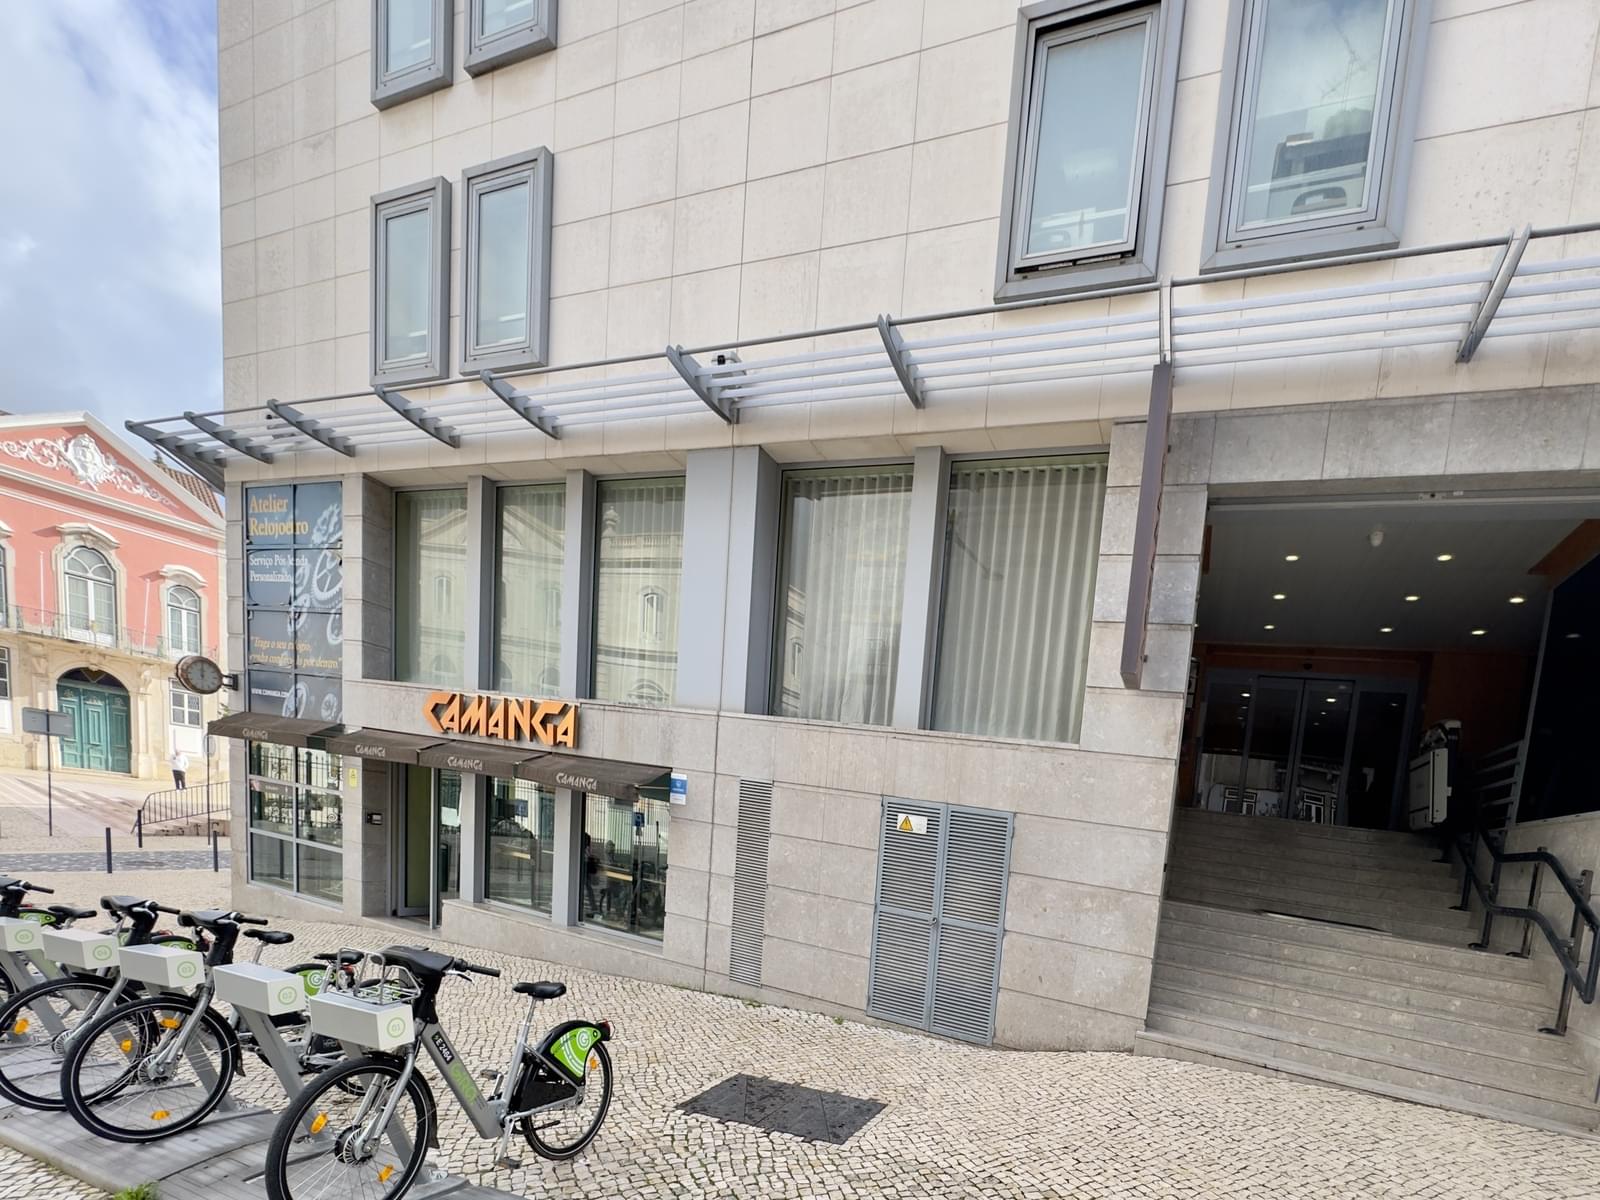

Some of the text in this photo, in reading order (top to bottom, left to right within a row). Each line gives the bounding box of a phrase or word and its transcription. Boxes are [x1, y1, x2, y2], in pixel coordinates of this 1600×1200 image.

[249, 494, 288, 512] Atelier
[249, 517, 309, 539] Relojoero
[249, 555, 272, 568] Serviço
[422, 691, 578, 748] CAMANGA
[242, 728, 268, 740] CAMANGA
[355, 744, 385, 757] CAMANGA
[447, 756, 483, 771] CAMANGA
[556, 772, 598, 790] CAMANGA
